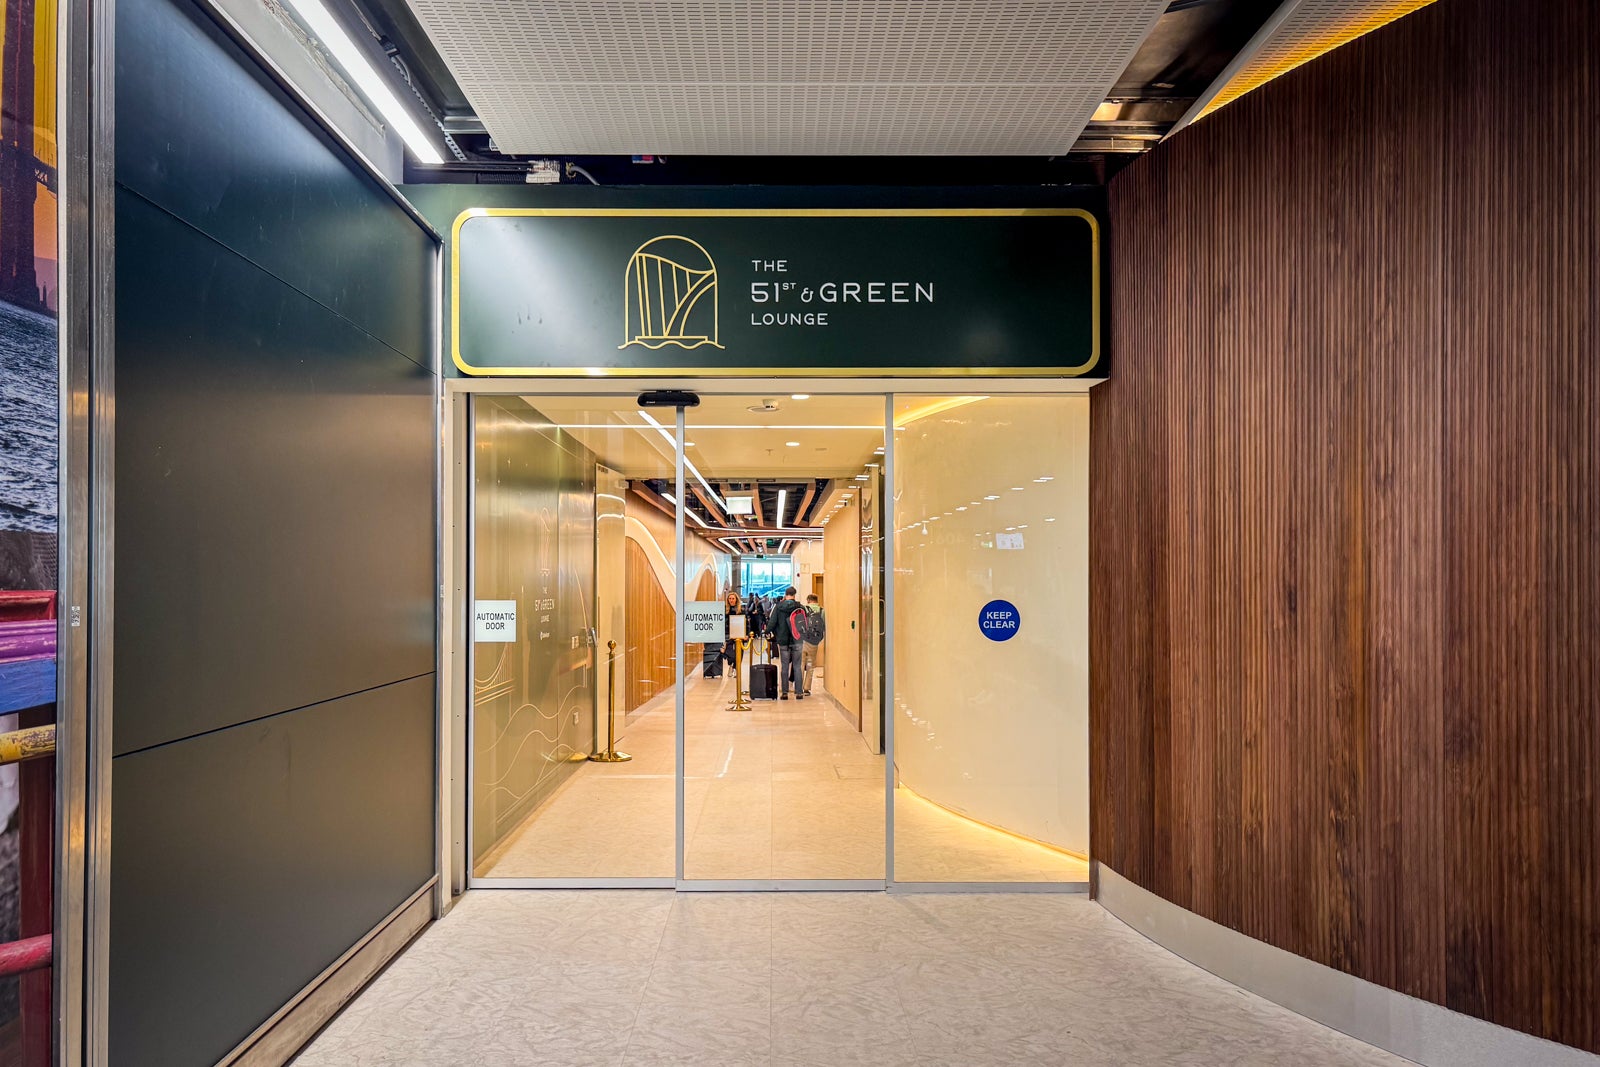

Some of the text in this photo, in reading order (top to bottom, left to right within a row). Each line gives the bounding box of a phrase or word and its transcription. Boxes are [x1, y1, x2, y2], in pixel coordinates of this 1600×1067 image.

[751, 259, 788, 272] THE
[800, 287, 814, 303] &
[819, 282, 934, 303] GREEN
[750, 312, 829, 326] LOUNGE
[476, 612, 515, 621] AUTOMATIC
[684, 613, 724, 622] AUTOMATIC
[986, 611, 1013, 620] KEEP
[485, 621, 506, 631] DOOR
[694, 622, 714, 632] DOOR
[982, 620, 1016, 629] CLEAR
